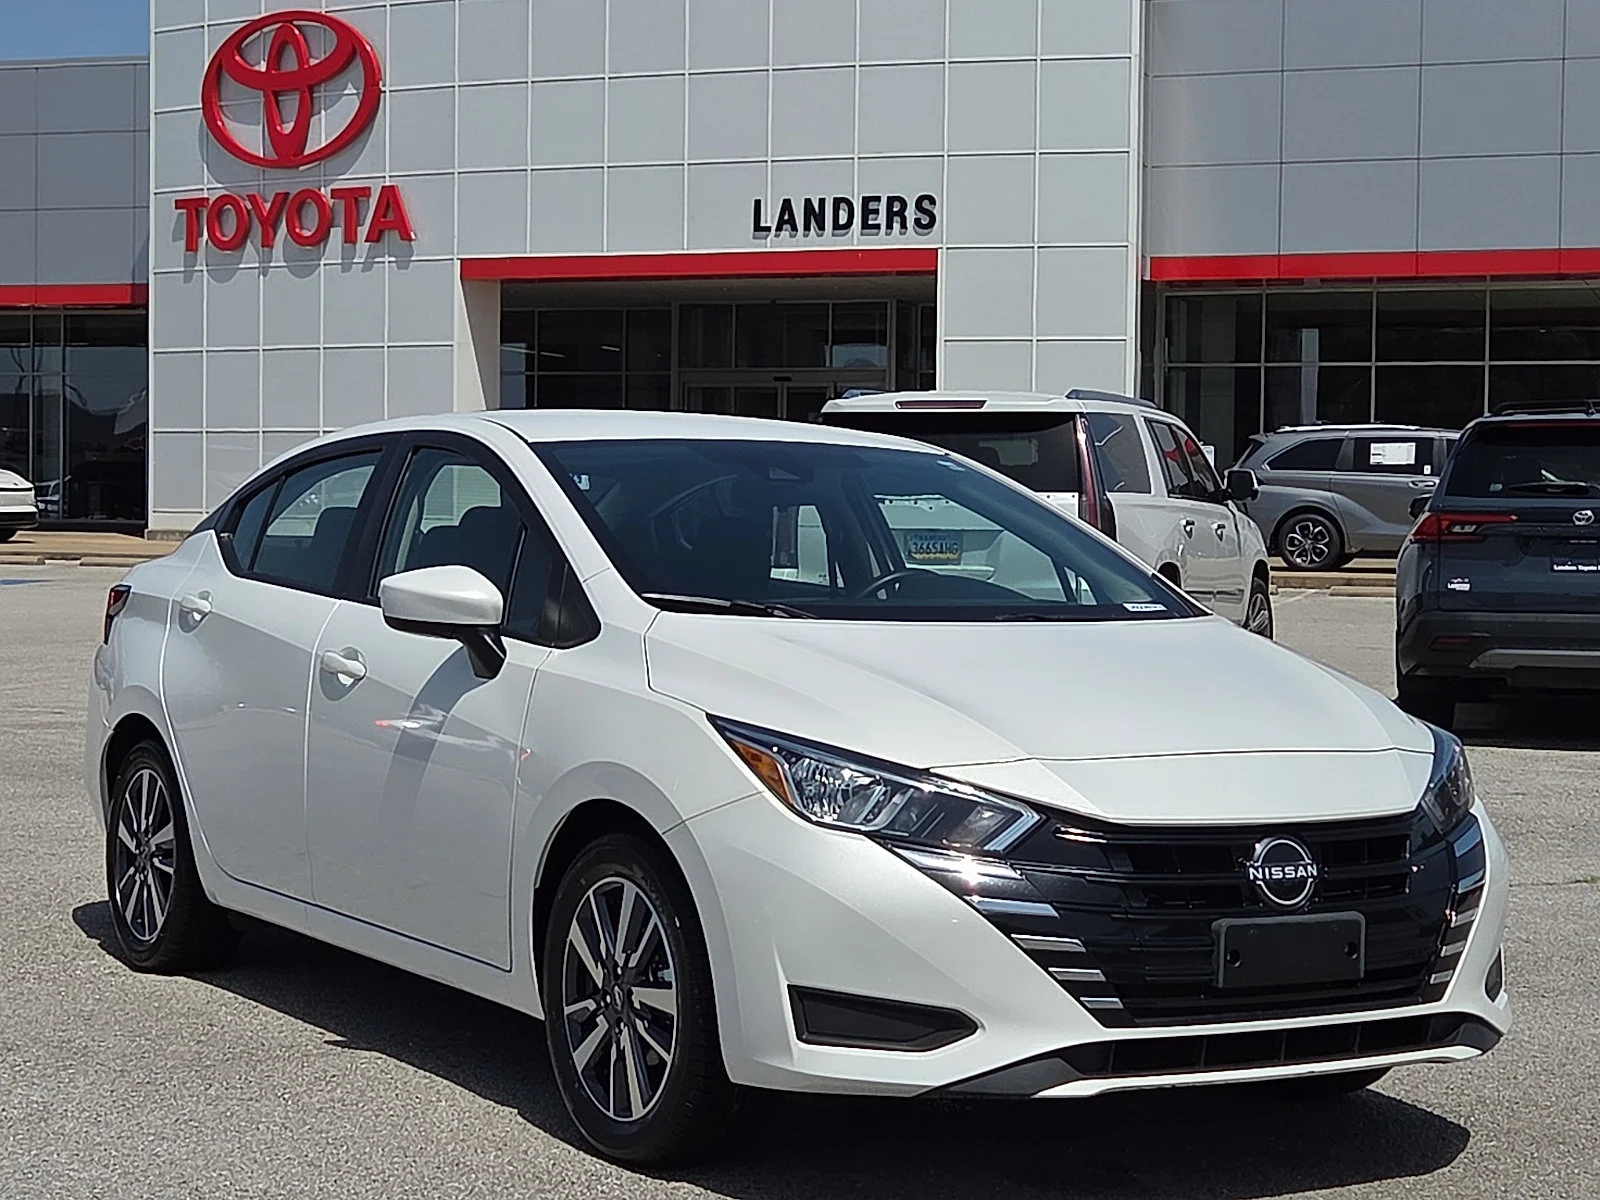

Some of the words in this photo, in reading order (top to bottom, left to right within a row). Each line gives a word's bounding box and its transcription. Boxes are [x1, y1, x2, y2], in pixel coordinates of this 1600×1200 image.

[175, 185, 415, 252] TOYOTA
[753, 194, 937, 235] LANDERS
[1248, 864, 1318, 881] NISSAN
